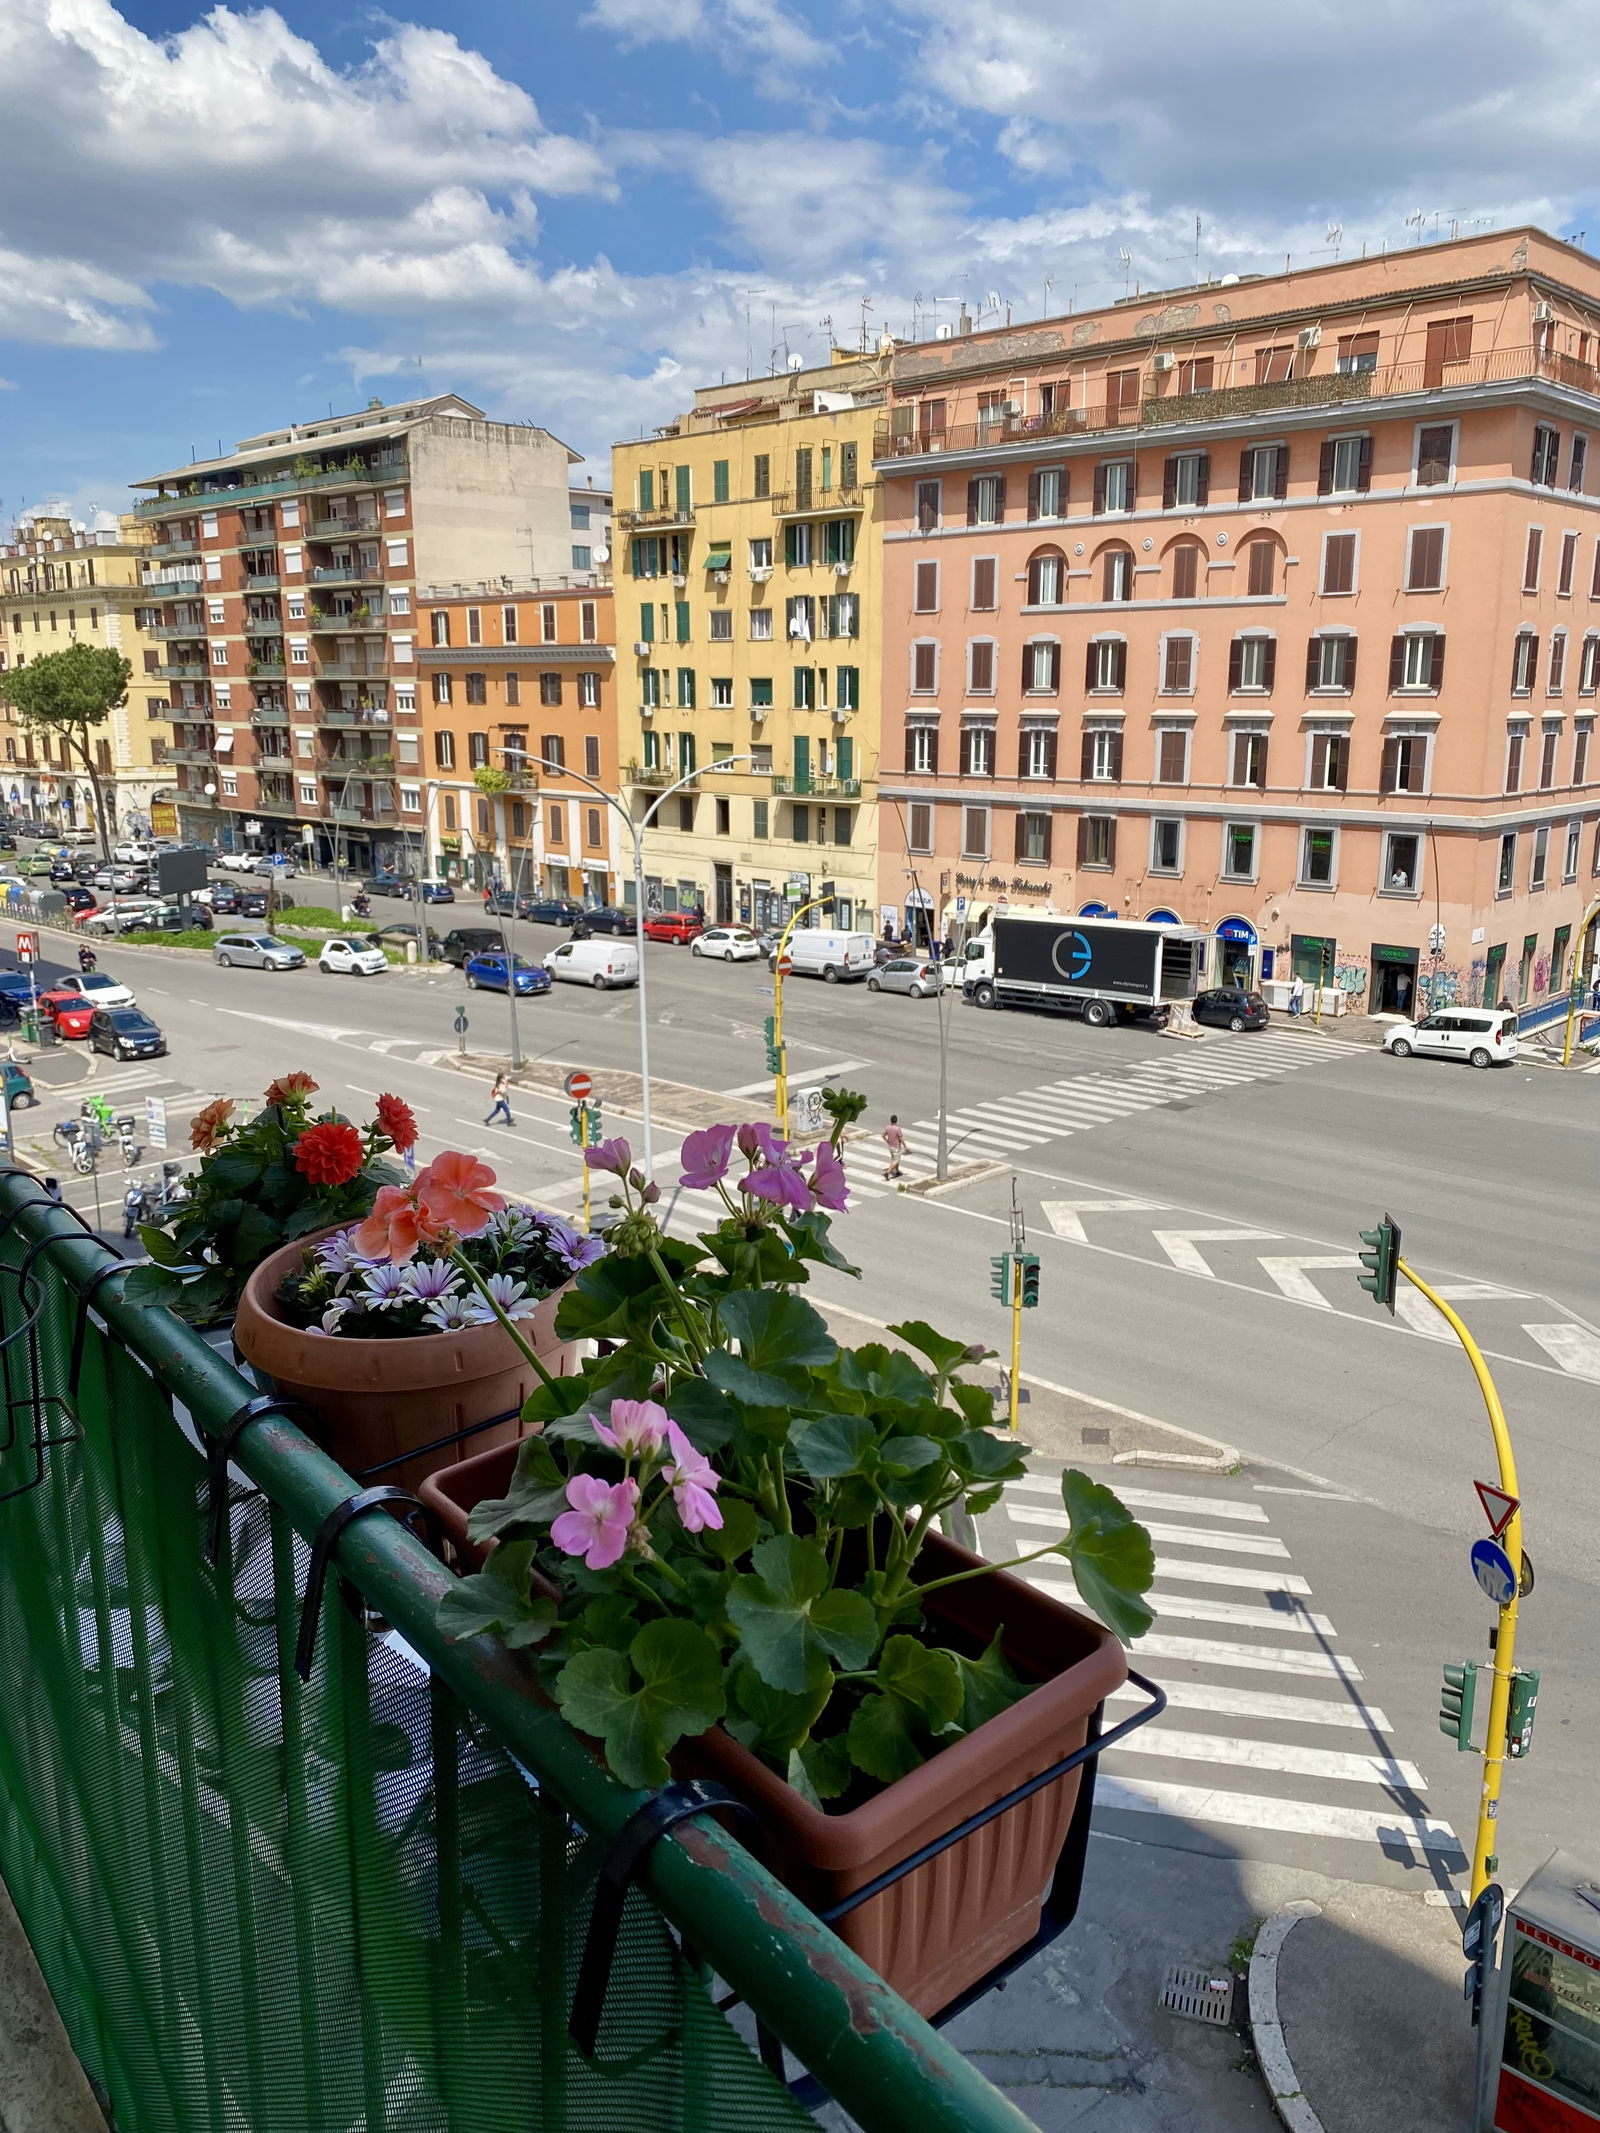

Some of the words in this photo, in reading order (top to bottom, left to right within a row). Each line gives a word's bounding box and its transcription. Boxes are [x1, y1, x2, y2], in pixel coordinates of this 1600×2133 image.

[274, 855, 282, 865] P
[958, 897, 965, 910] P
[1233, 929, 1249, 939] TIM
[18, 936, 31, 950] M
[1522, 1924, 1600, 1971] TELEFO
